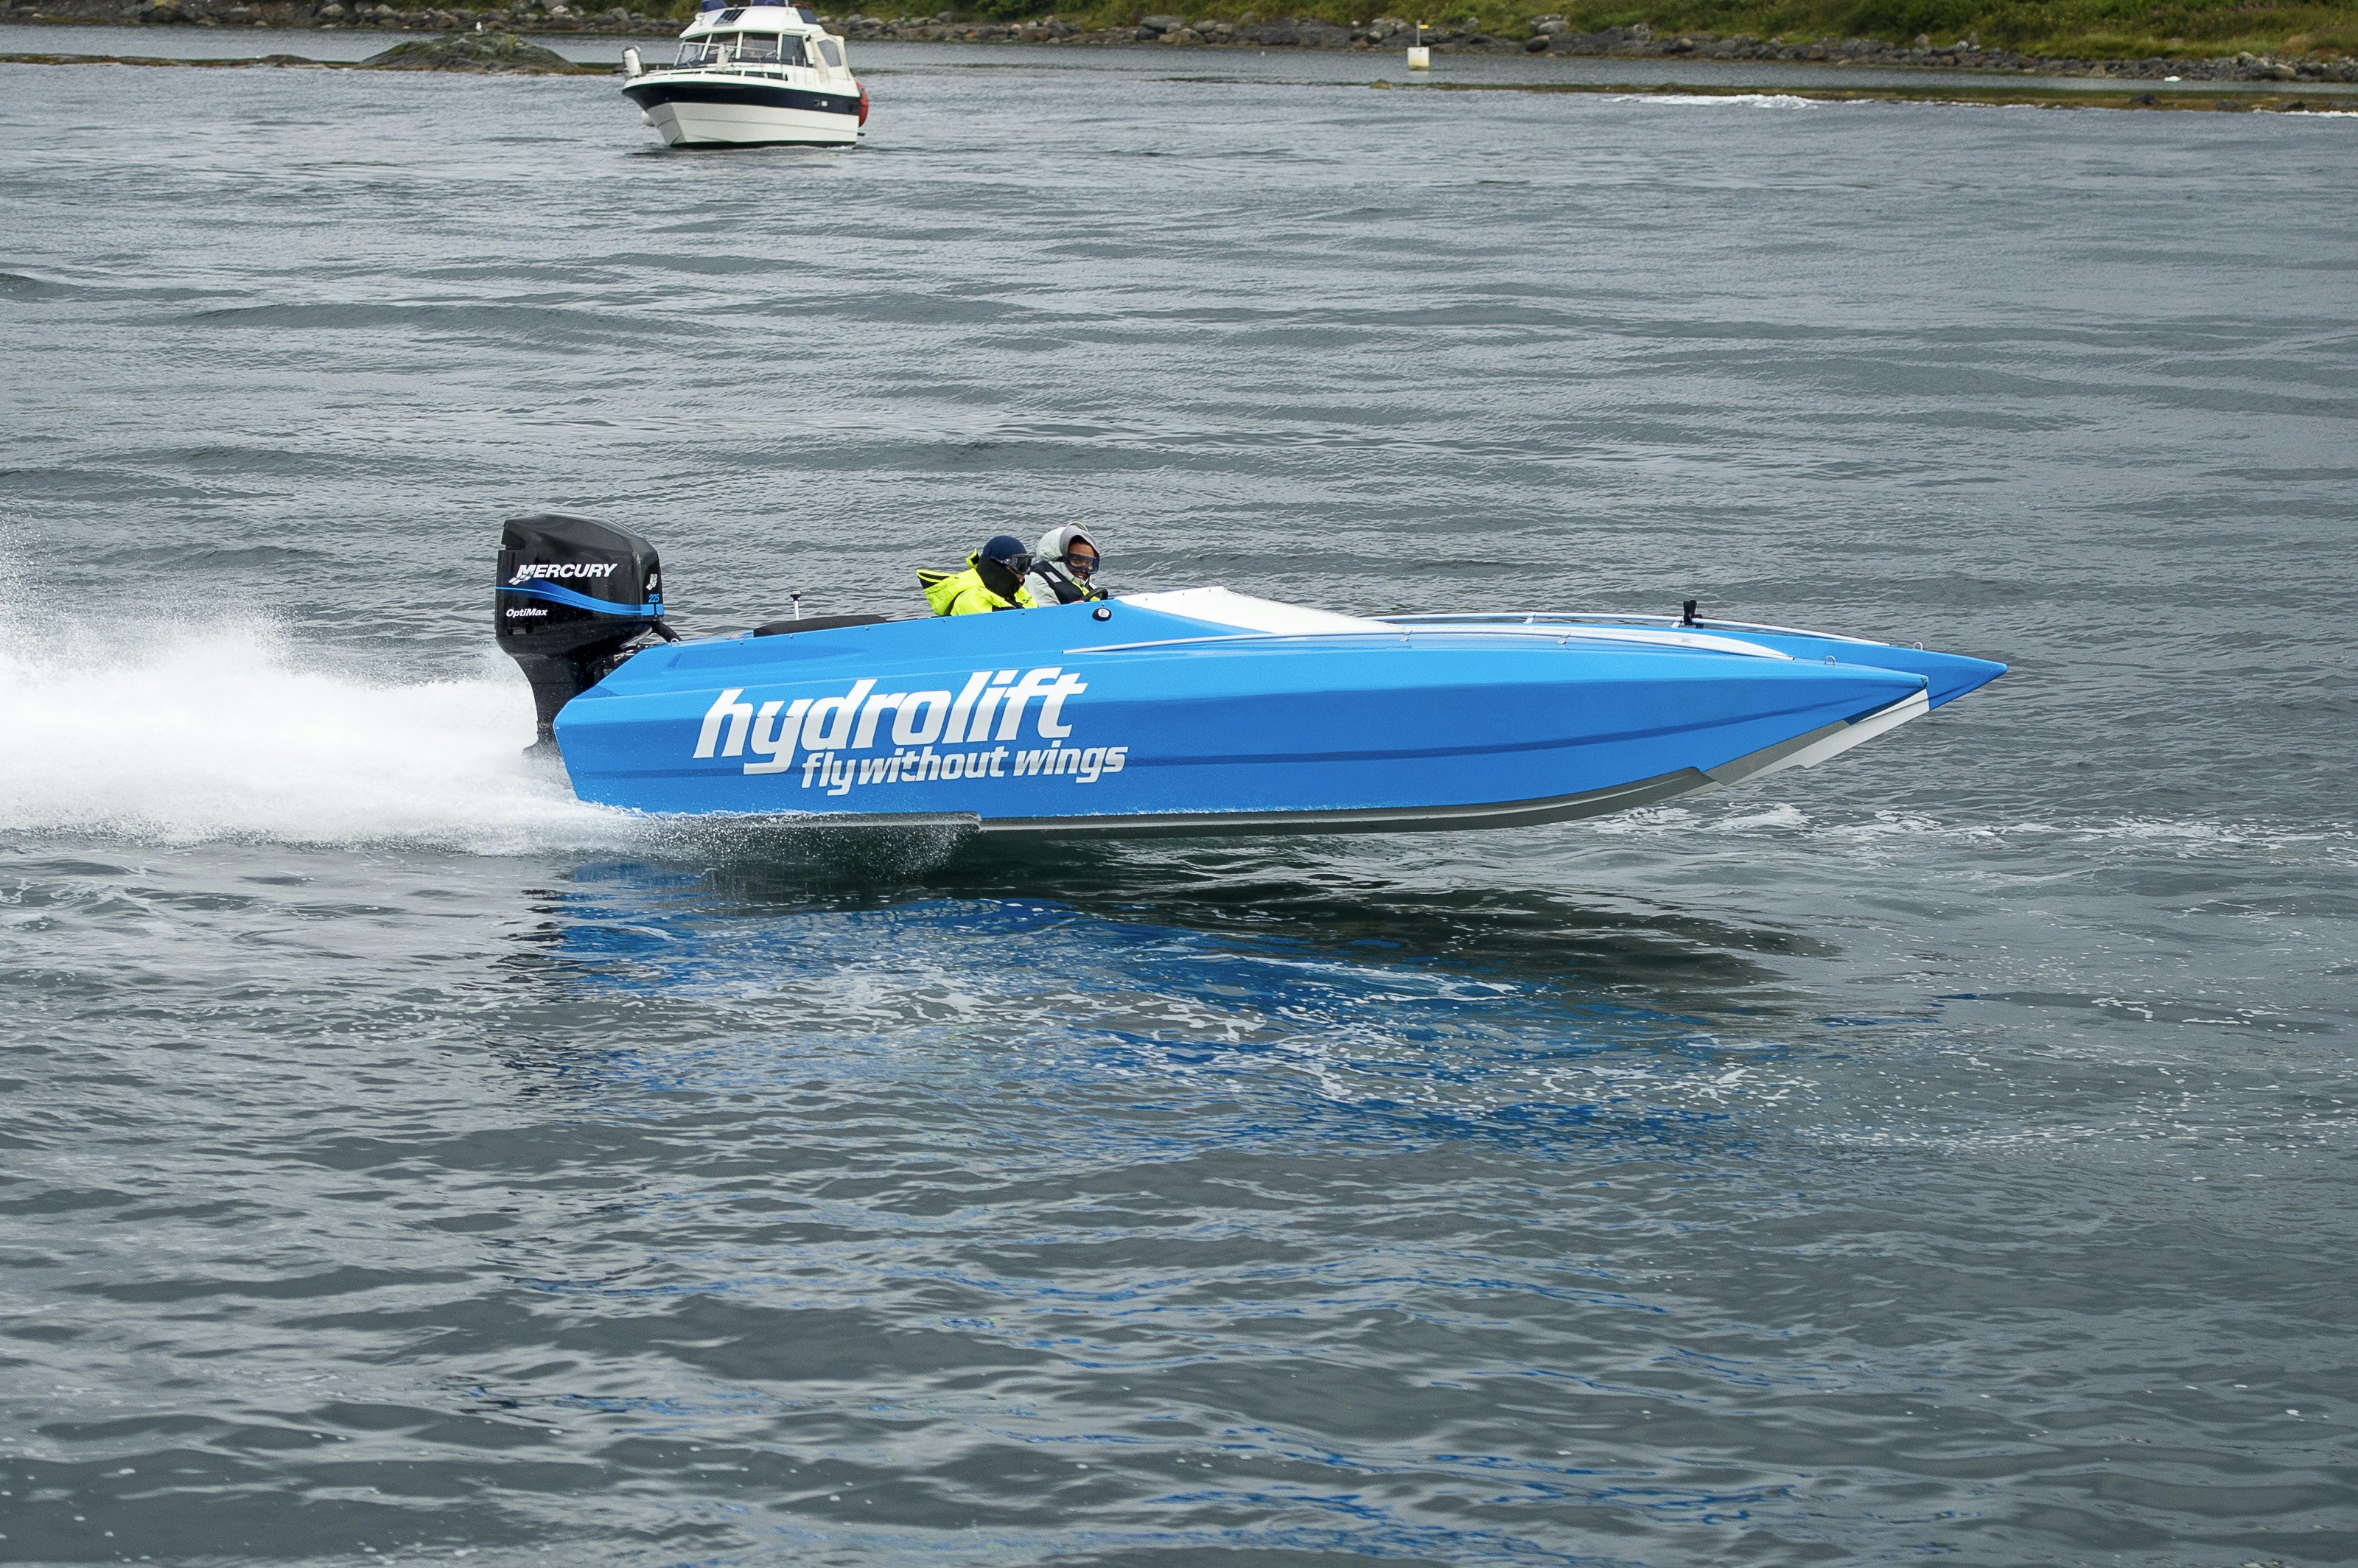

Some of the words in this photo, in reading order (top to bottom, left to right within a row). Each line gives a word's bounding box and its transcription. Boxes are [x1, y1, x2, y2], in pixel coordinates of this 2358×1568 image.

[514, 563, 618, 582] MERCURY
[648, 593, 660, 603] 225
[505, 608, 548, 619] OptiMax
[693, 667, 1088, 775] hydrolift
[801, 752, 856, 796] fly
[858, 746, 1010, 783] without
[1013, 740, 1129, 783] wings
